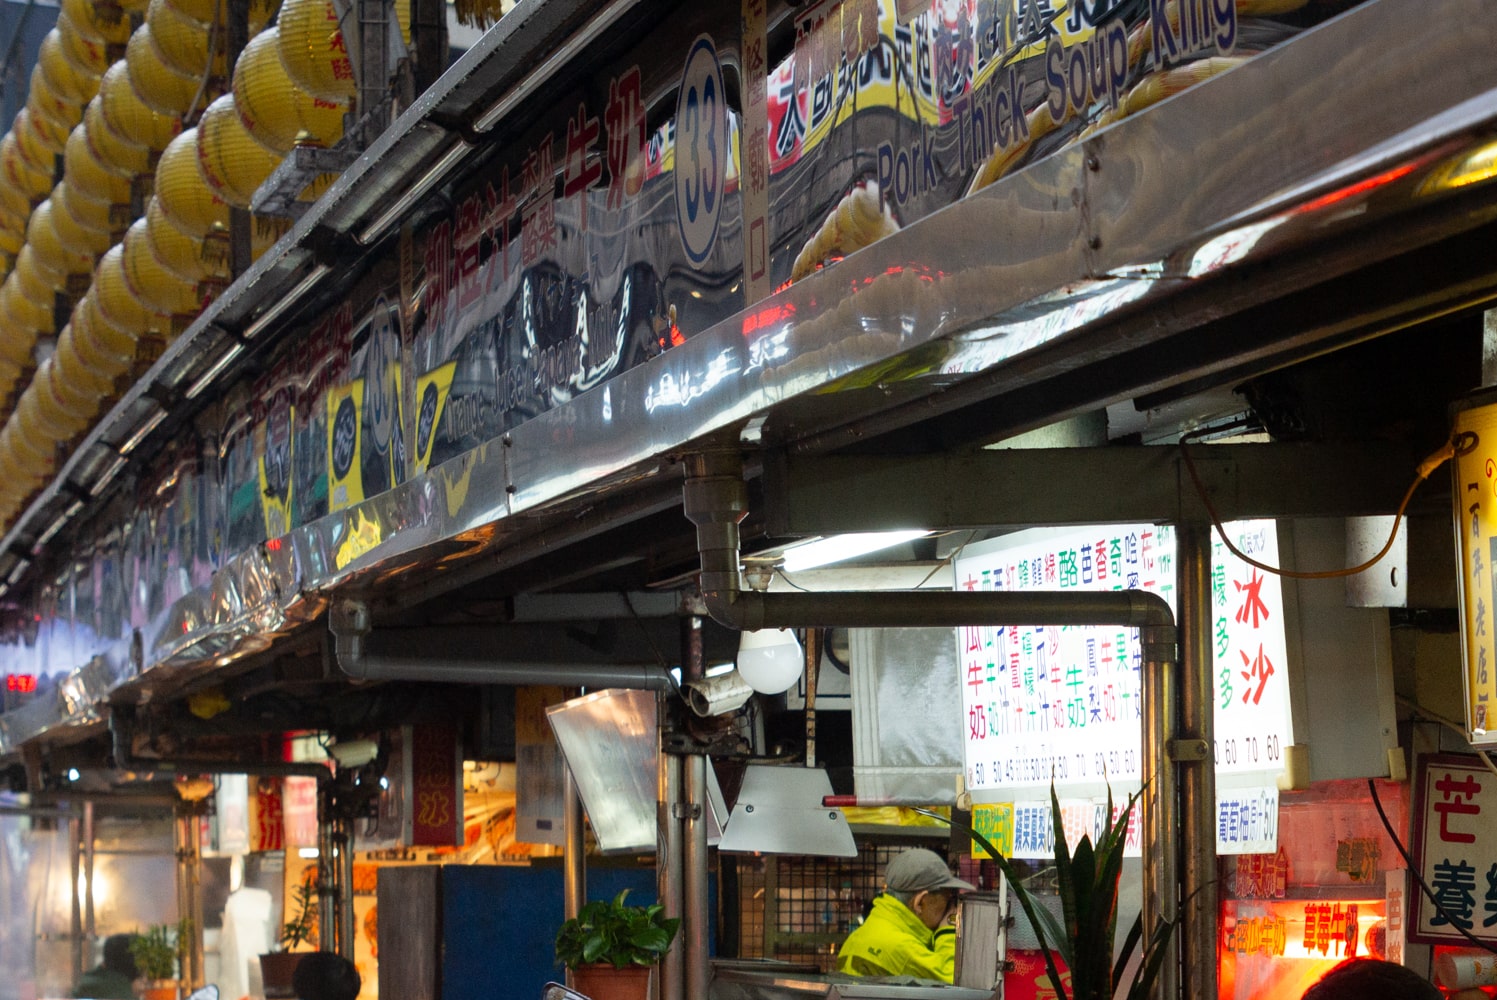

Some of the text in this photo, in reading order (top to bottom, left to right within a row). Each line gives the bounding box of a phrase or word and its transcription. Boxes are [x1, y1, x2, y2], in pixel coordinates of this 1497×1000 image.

[563, 65, 648, 232] 牛奶
[685, 74, 717, 223] 33
[877, 124, 937, 213] Pork
[951, 74, 1031, 176] Thick
[1046, 19, 1129, 126] Soup
[446, 386, 485, 443] Orange
[588, 304, 619, 366] Milk
[1059, 547, 1087, 729] 酪牛奶
[1096, 539, 1117, 722] 香牛奶
[1234, 566, 1275, 706] 冰沙
[975, 762, 984, 785] 50
[993, 760, 1002, 783] 50
[1031, 758, 1041, 781] 50
[1058, 756, 1068, 779] 50
[1077, 754, 1086, 777] 70
[1095, 752, 1104, 776] 60
[1110, 751, 1120, 775] 50
[1125, 749, 1135, 773] 60
[1225, 740, 1237, 765] 60
[1246, 737, 1258, 763] 70
[1267, 735, 1279, 761] 60
[1263, 798, 1276, 841] 50
